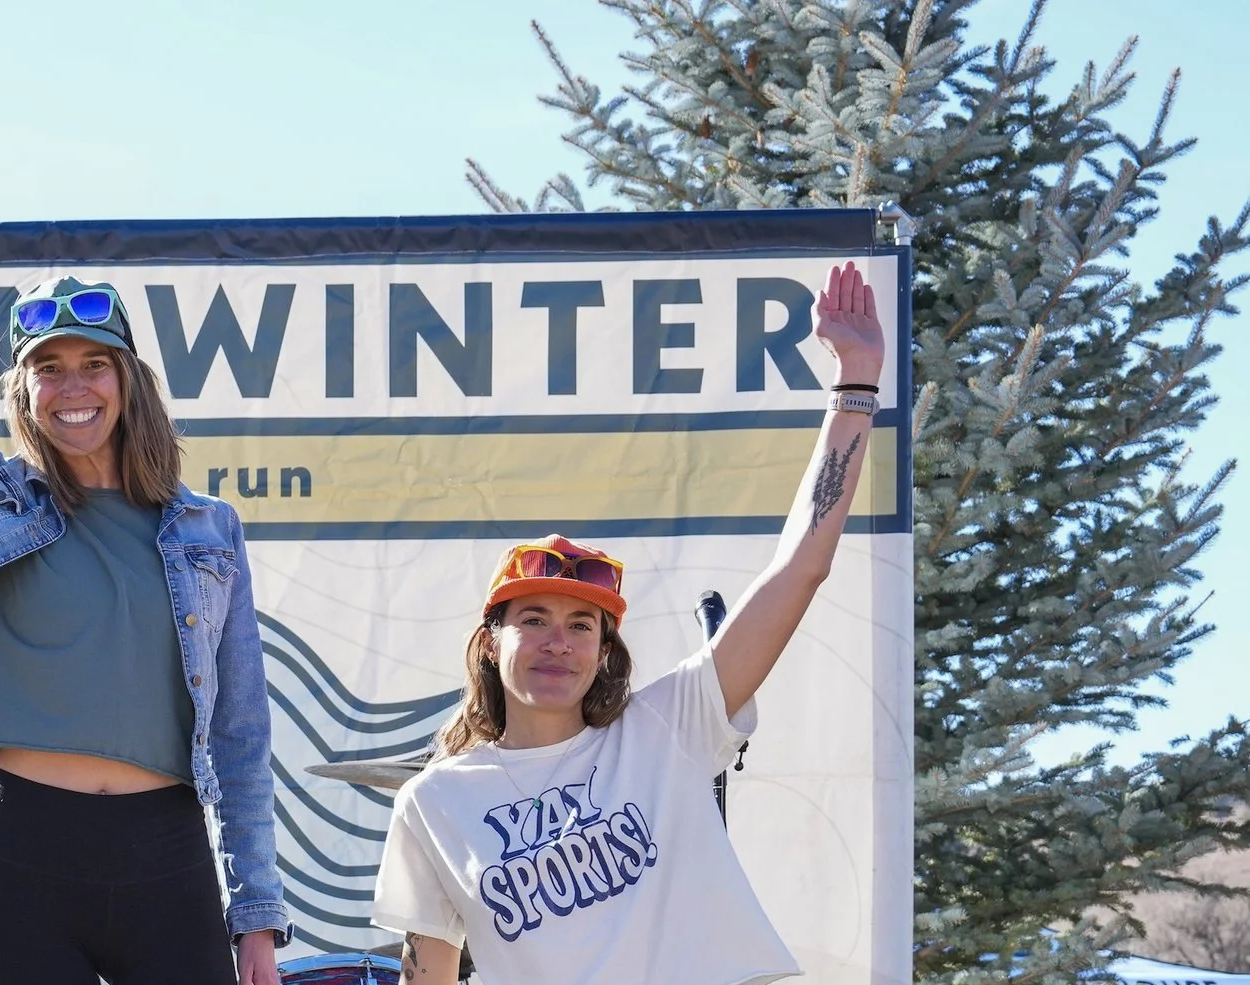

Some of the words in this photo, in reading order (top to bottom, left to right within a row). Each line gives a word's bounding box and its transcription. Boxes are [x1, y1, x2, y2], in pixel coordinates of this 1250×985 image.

[144, 277, 824, 399] WINTER
[208, 466, 312, 499] run
[484, 766, 602, 860] YAY
[480, 803, 658, 942] SPORTS!
